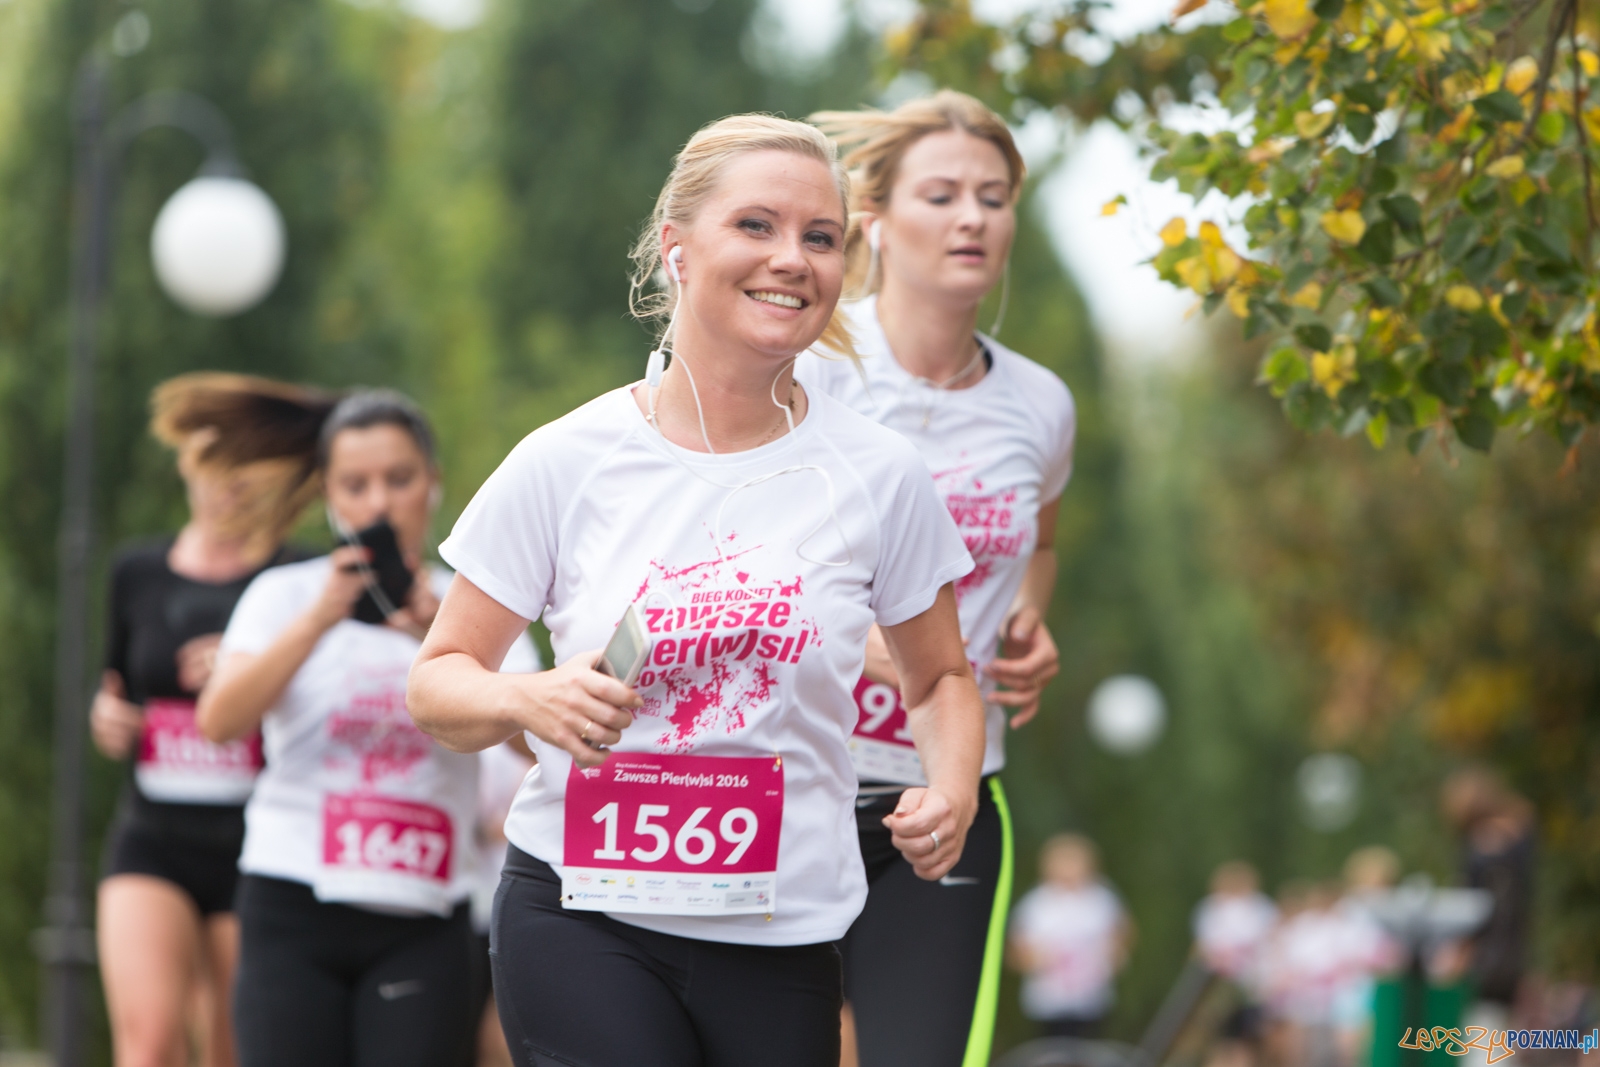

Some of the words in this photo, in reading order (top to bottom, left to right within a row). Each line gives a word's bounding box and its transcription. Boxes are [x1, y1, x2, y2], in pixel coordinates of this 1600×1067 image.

[691, 590, 723, 604] BIEG
[725, 587, 775, 602] KOBIET
[645, 601, 791, 634] zawsze
[613, 769, 659, 784] Zawsze
[661, 772, 713, 788] Pier(w)si
[716, 774, 749, 788] 2016
[336, 820, 447, 873] 1647
[592, 802, 758, 865] 1569
